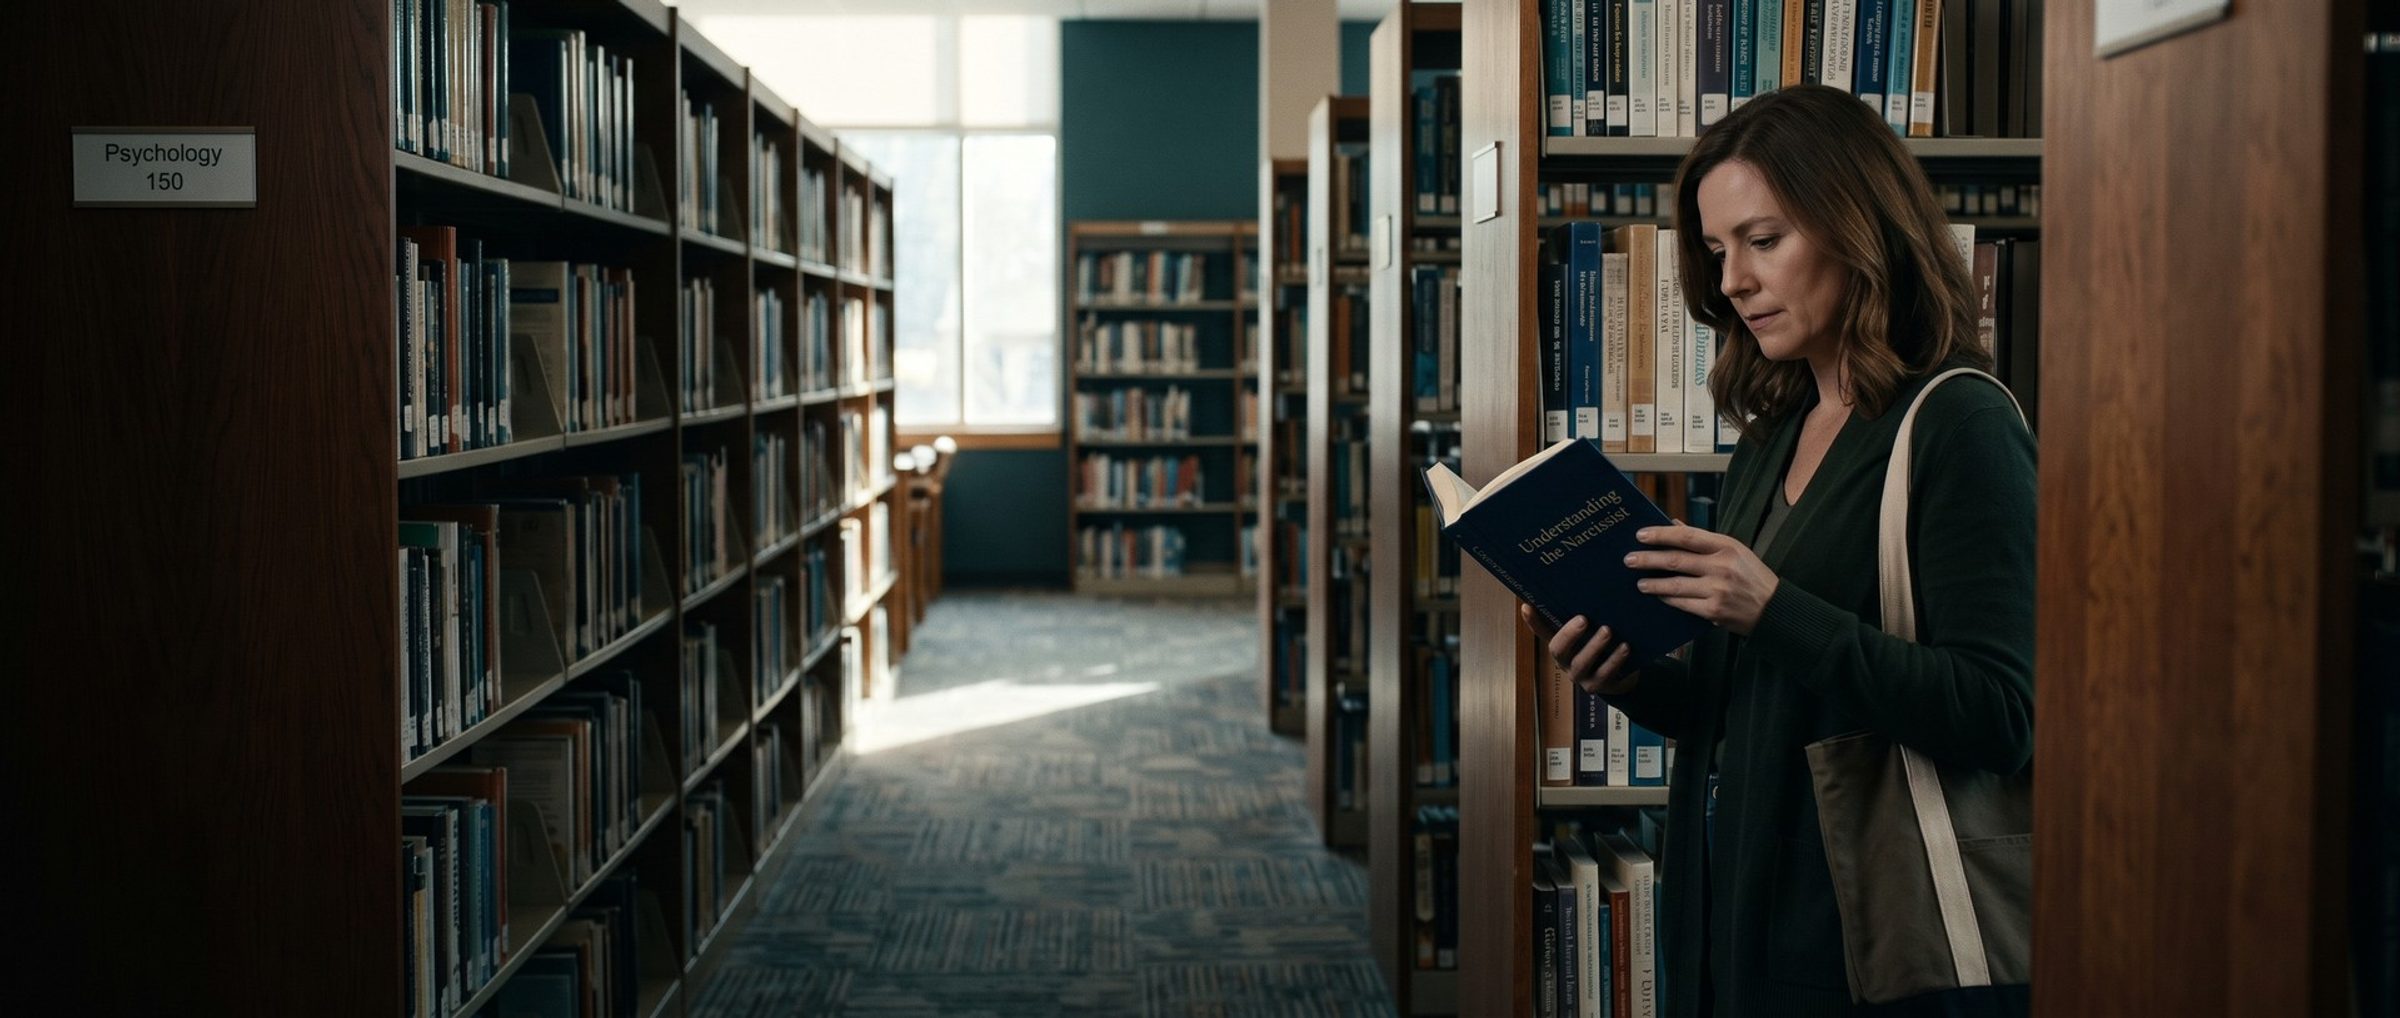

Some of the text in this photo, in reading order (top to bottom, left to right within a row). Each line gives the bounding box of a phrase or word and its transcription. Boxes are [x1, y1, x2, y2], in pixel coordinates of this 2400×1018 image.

[105, 143, 223, 167] Psychology
[146, 172, 184, 191] 150
[1518, 490, 1622, 553] Understanding
[1540, 506, 1631, 565] the Narcissist
